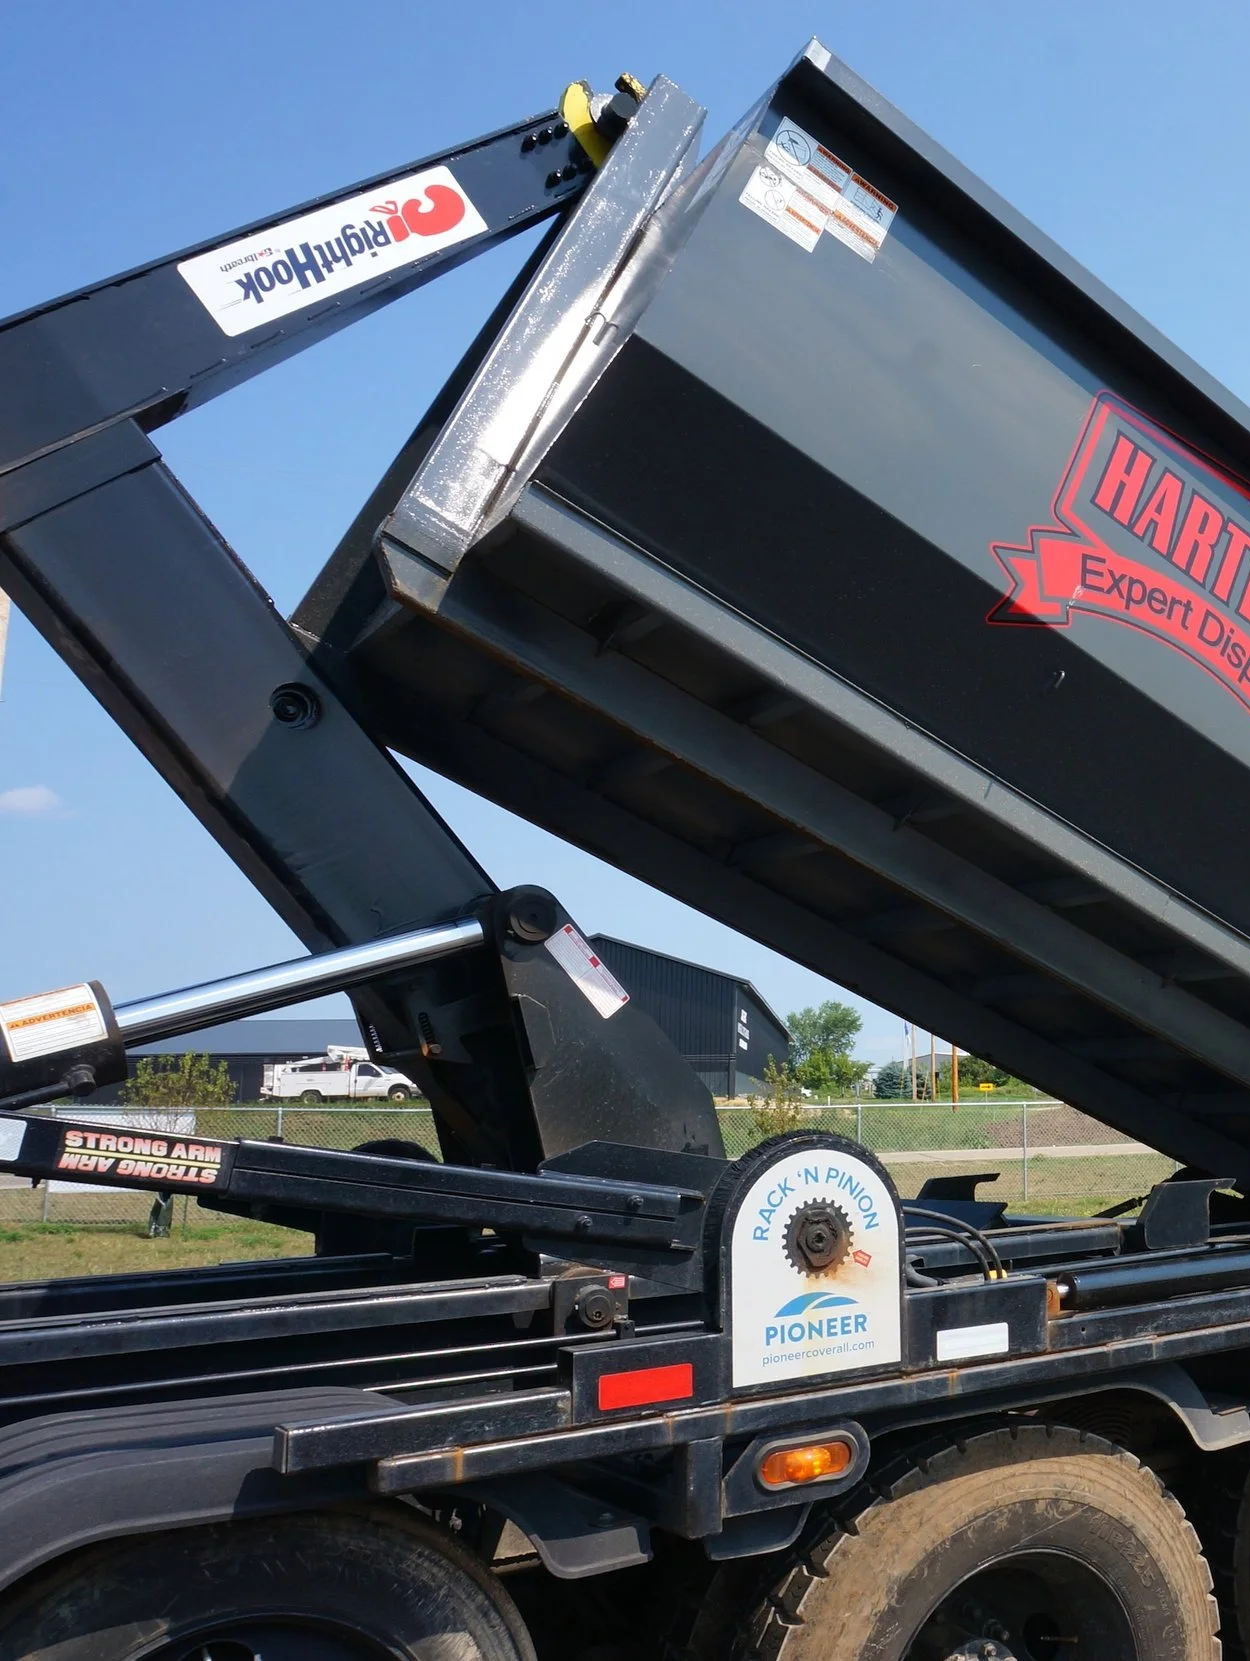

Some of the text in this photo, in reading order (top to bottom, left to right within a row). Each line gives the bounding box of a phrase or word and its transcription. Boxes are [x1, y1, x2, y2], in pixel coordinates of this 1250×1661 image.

[856, 175, 895, 212] WARNING
[235, 219, 392, 304] RightHook
[1080, 553, 1195, 630] Expert
[22, 1003, 93, 1026] ADVERTENCIA
[65, 1130, 222, 1162] STRONG ARM
[58, 1153, 218, 1184] STRONG ARM
[752, 1178, 796, 1241] RACK
[825, 1167, 880, 1231] PINION
[765, 1313, 868, 1347] PIONEER
[762, 1338, 876, 1368] pioneercoverall.com
